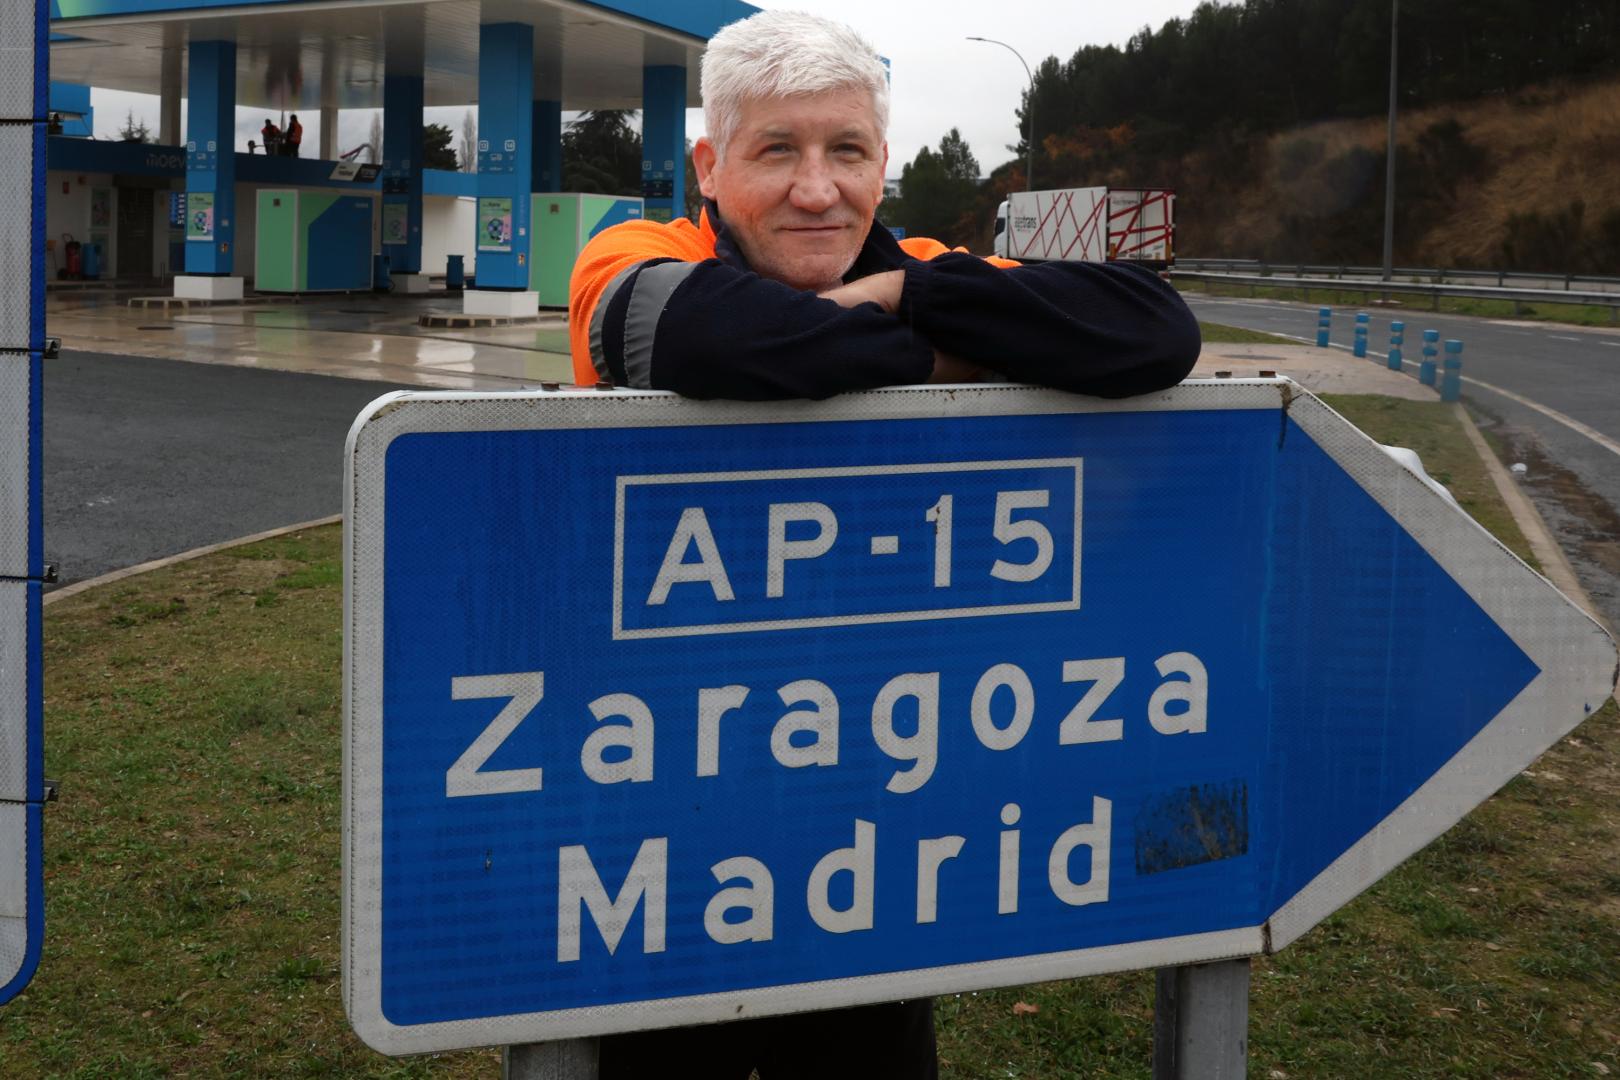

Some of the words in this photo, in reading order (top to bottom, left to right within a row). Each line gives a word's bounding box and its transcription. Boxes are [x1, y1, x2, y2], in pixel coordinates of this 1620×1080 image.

[647, 490, 1053, 604] AP-15
[446, 652, 1208, 797] Zaragoza
[557, 796, 1112, 962] Madrid
